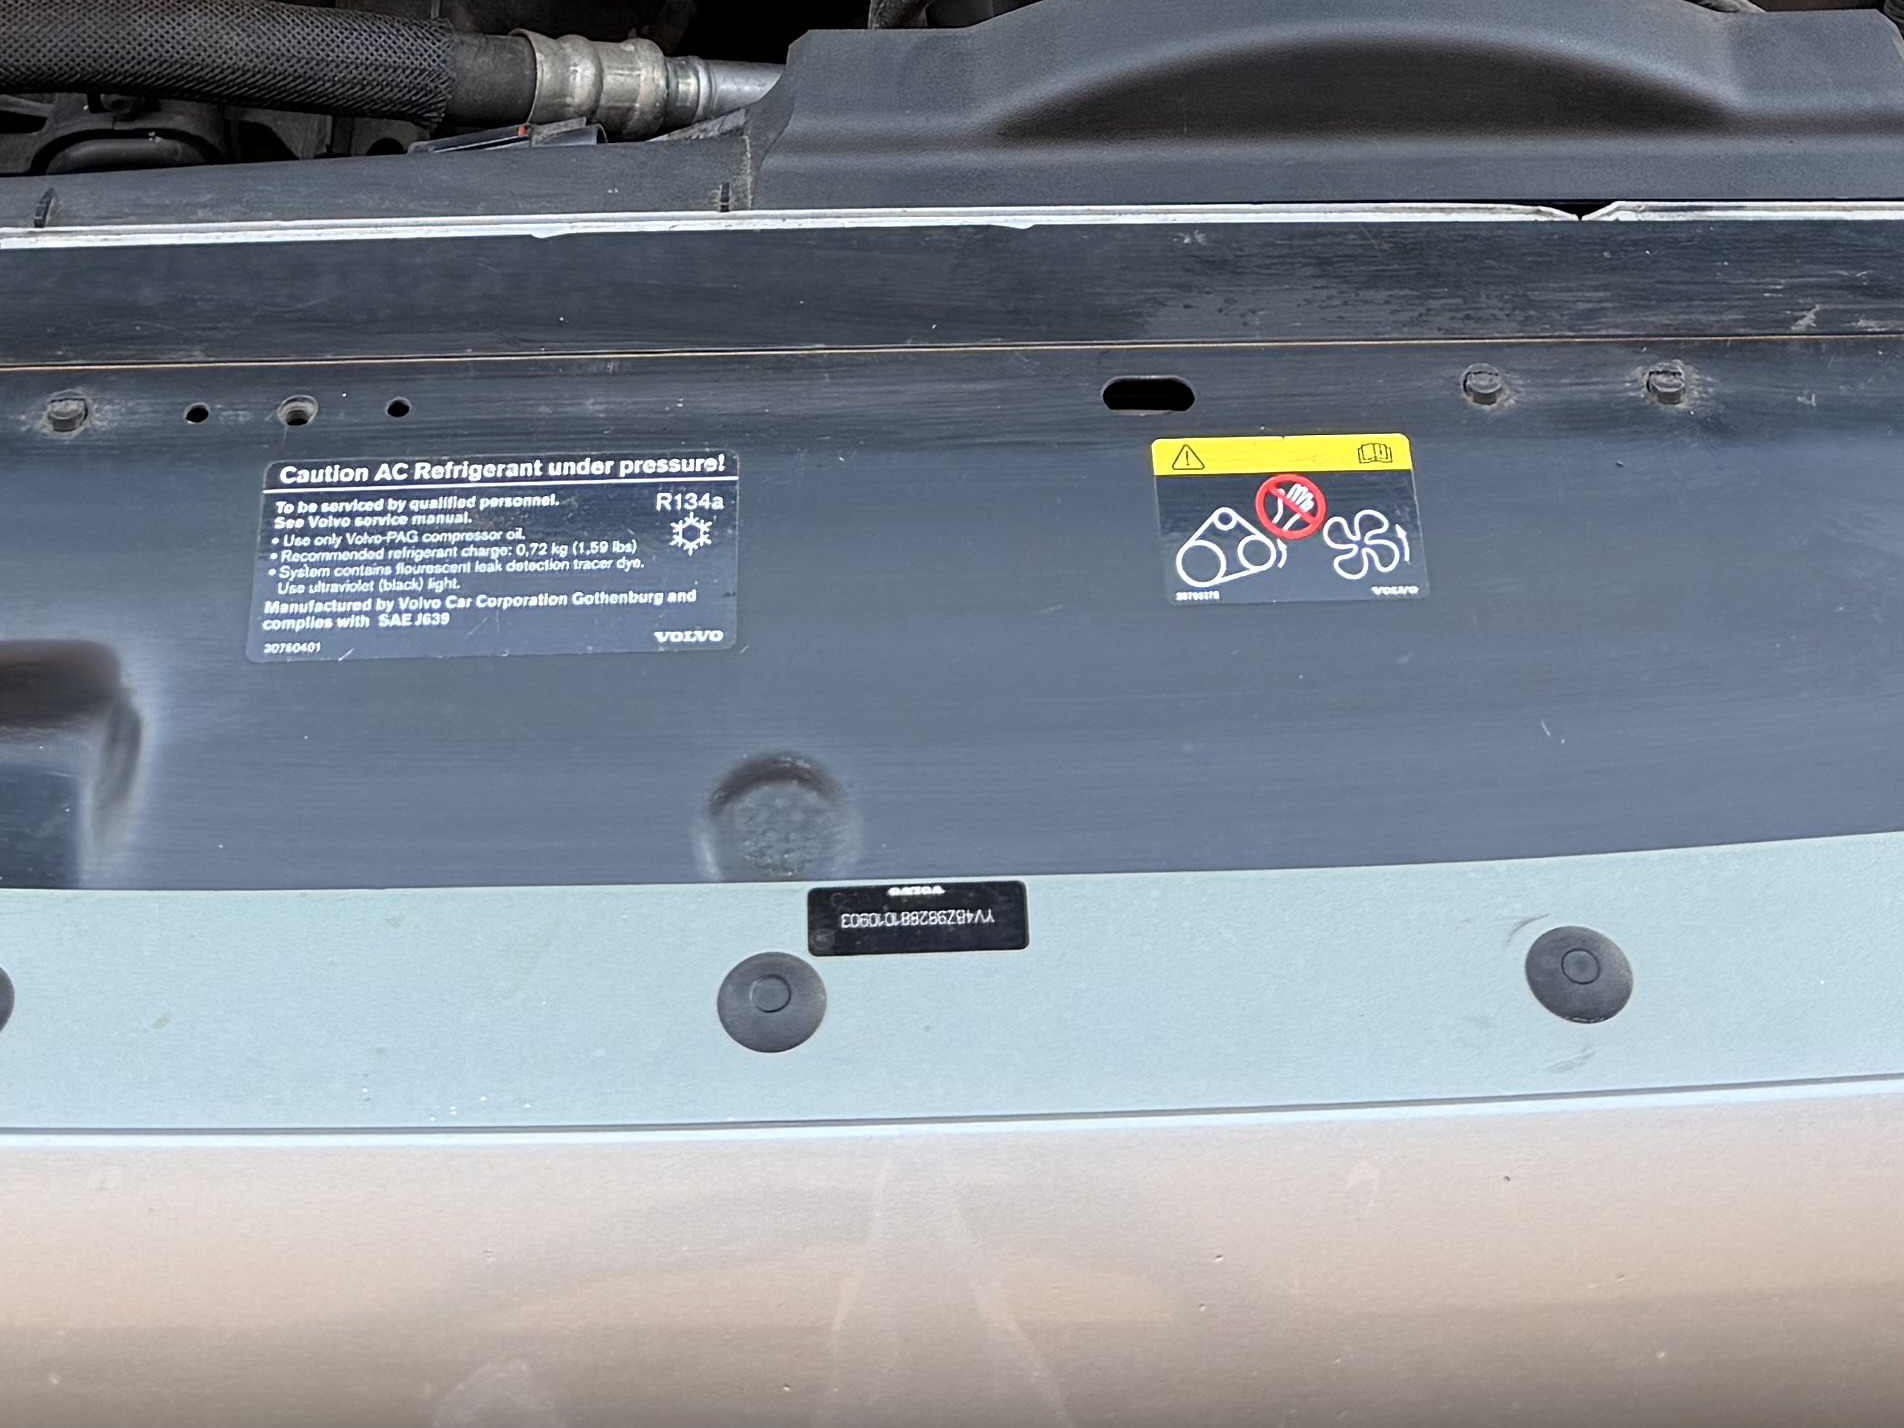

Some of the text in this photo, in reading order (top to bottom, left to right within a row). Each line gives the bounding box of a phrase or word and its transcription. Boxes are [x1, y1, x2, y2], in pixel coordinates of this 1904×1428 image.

[279, 454, 726, 485] Caution AC Refrigerant under pressure!
[276, 494, 559, 514] To be serviced by qualified personnel.
[656, 492, 725, 511] R134a
[274, 511, 472, 529] See Volvo service manual.
[283, 528, 526, 548] Use only Volvo-PAG compressor oil.
[280, 549, 385, 563] Recommended
[388, 547, 457, 563] refrigerant
[461, 544, 512, 560] charge:
[516, 543, 547, 556] 0,72
[551, 542, 568, 557] kg
[612, 539, 637, 554] lbs)
[279, 565, 330, 581] System
[334, 564, 392, 577] contains
[475, 560, 503, 573] leak
[506, 560, 569, 572] detection
[574, 559, 613, 570] tracer
[617, 558, 645, 572] dye.
[277, 578, 460, 595] Use ultraviolet (black) light.
[1371, 586, 1419, 595] VOLVO
[264, 589, 697, 614] Manufactured by Volvo Car Corporation Gothenburg and
[262, 612, 450, 632] complies with SAE J639
[654, 630, 724, 643] VOLVO
[887, 885, 945, 896] VOLVO
